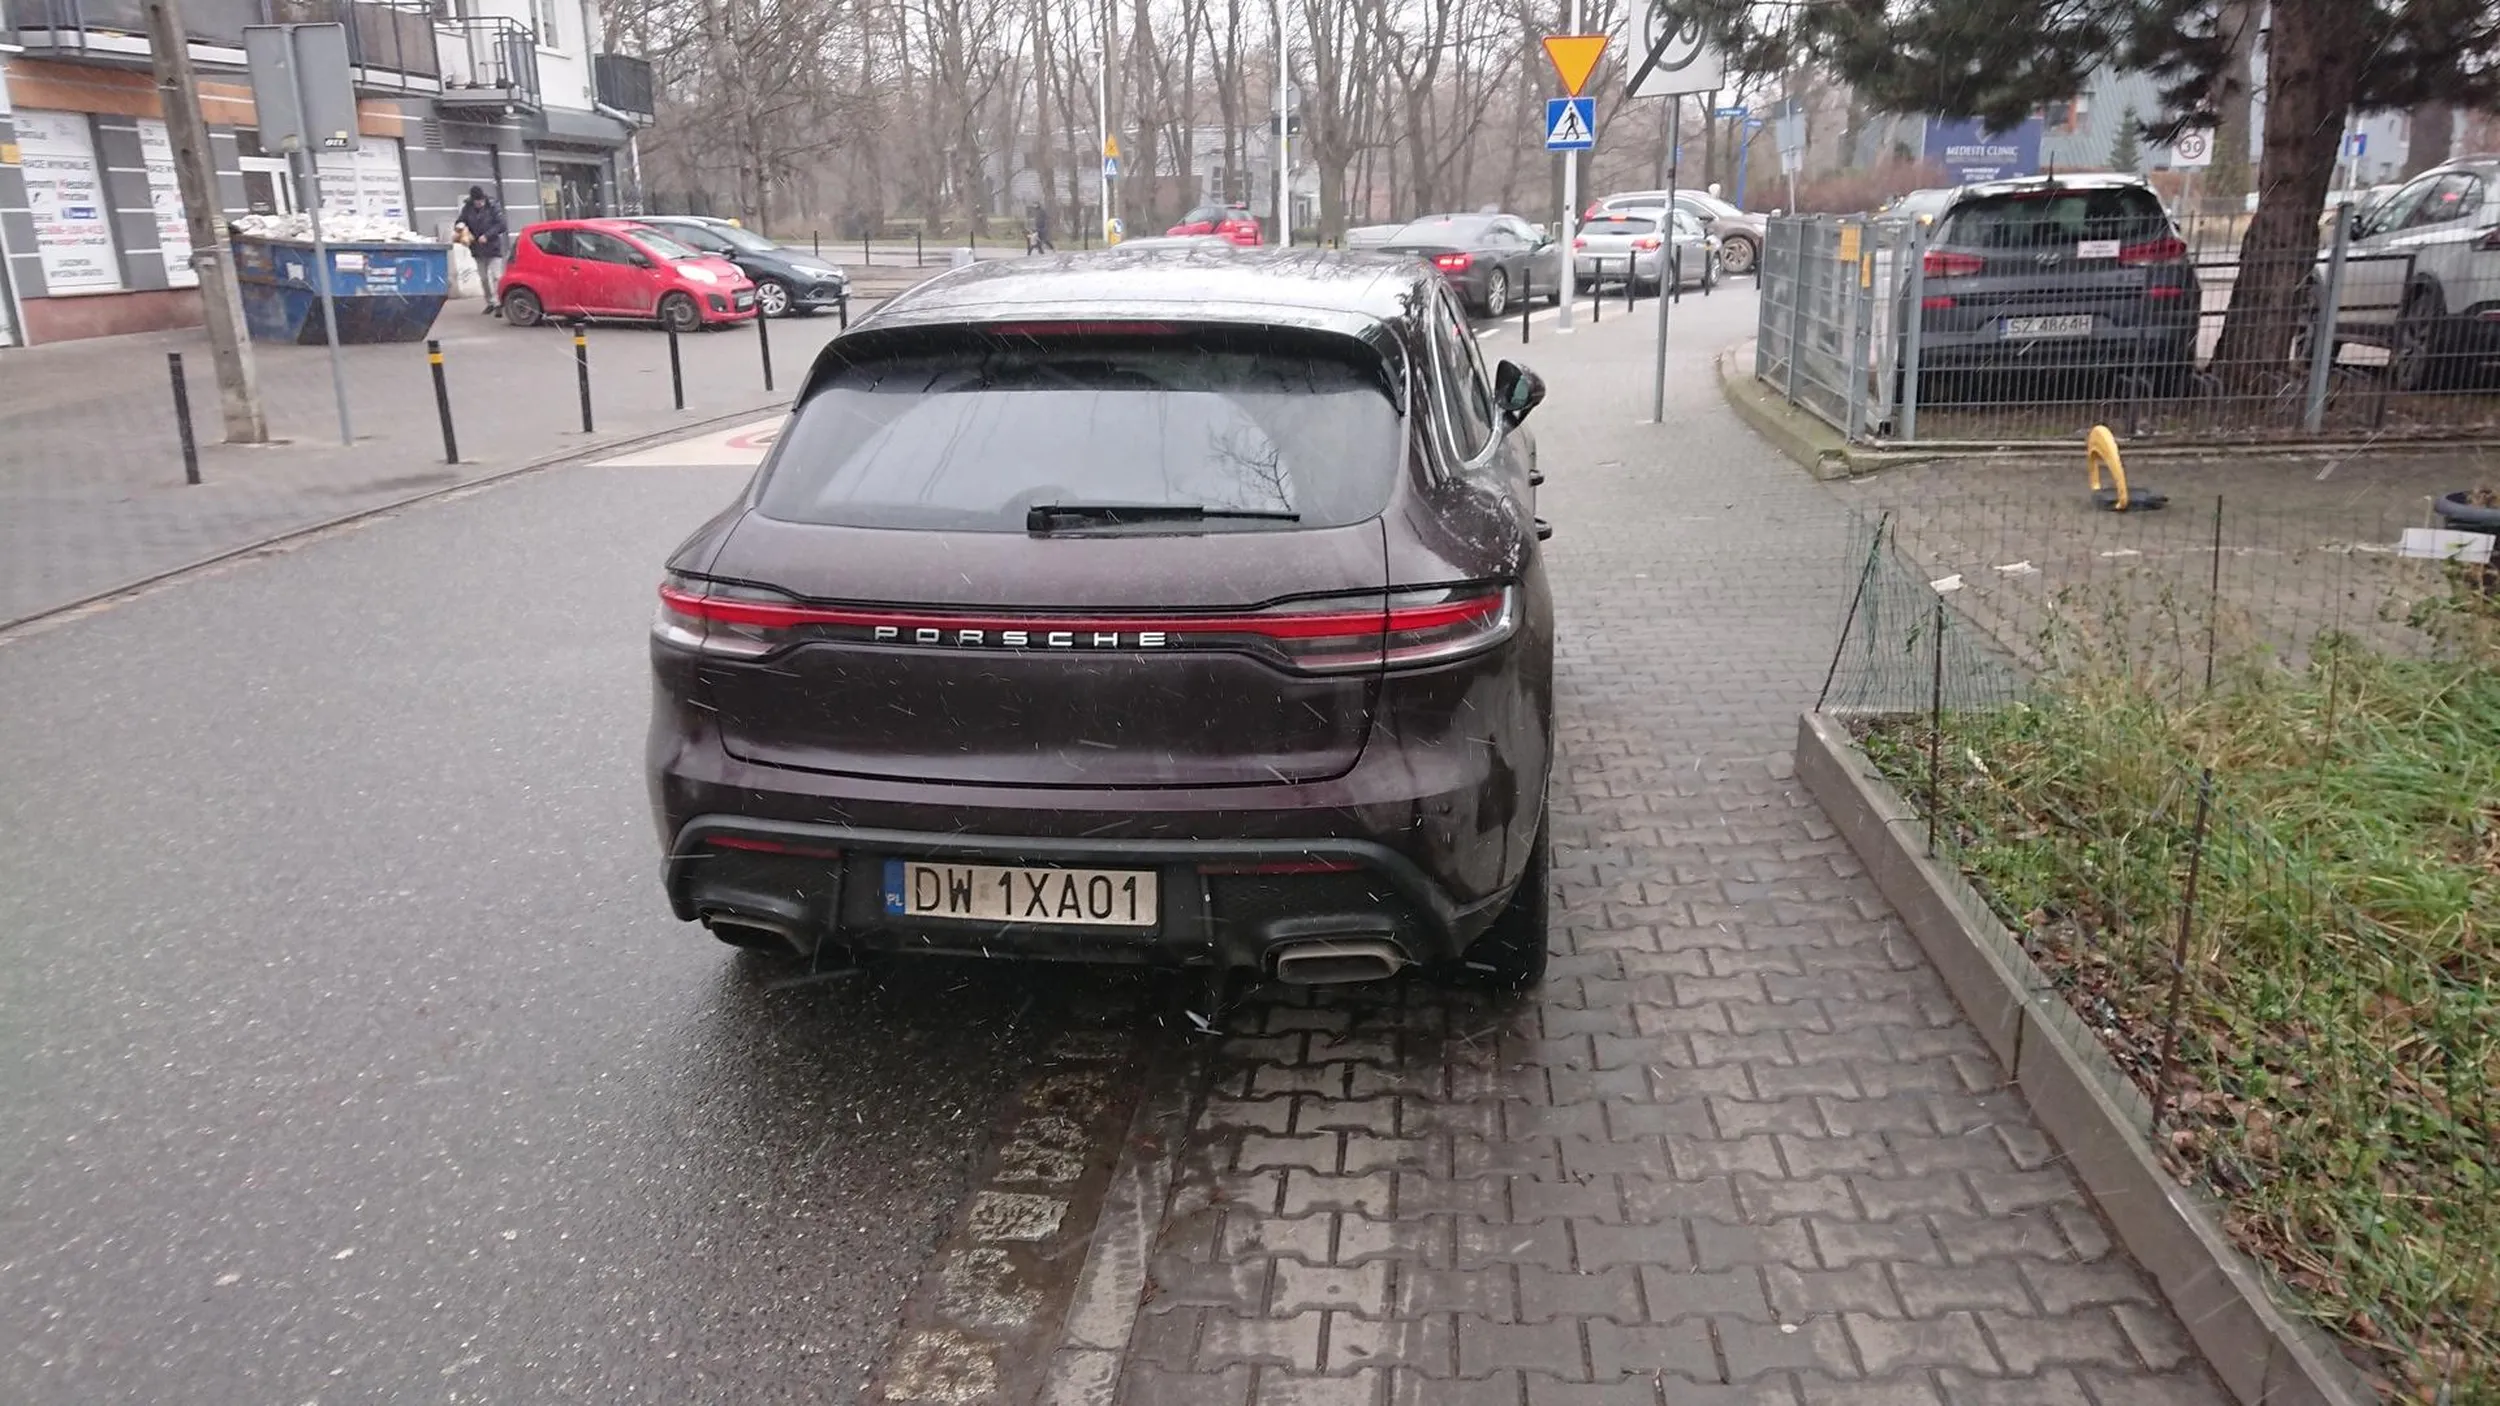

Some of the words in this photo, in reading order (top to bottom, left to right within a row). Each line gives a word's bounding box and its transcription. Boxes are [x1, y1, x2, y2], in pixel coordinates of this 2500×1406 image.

[2184, 140, 2201, 152] 30
[2010, 319, 2033, 334] SZ
[875, 626, 1166, 647] PORSCHE
[887, 892, 904, 906] PL
[915, 867, 973, 913] DW
[998, 871, 1138, 921] 1XA01
